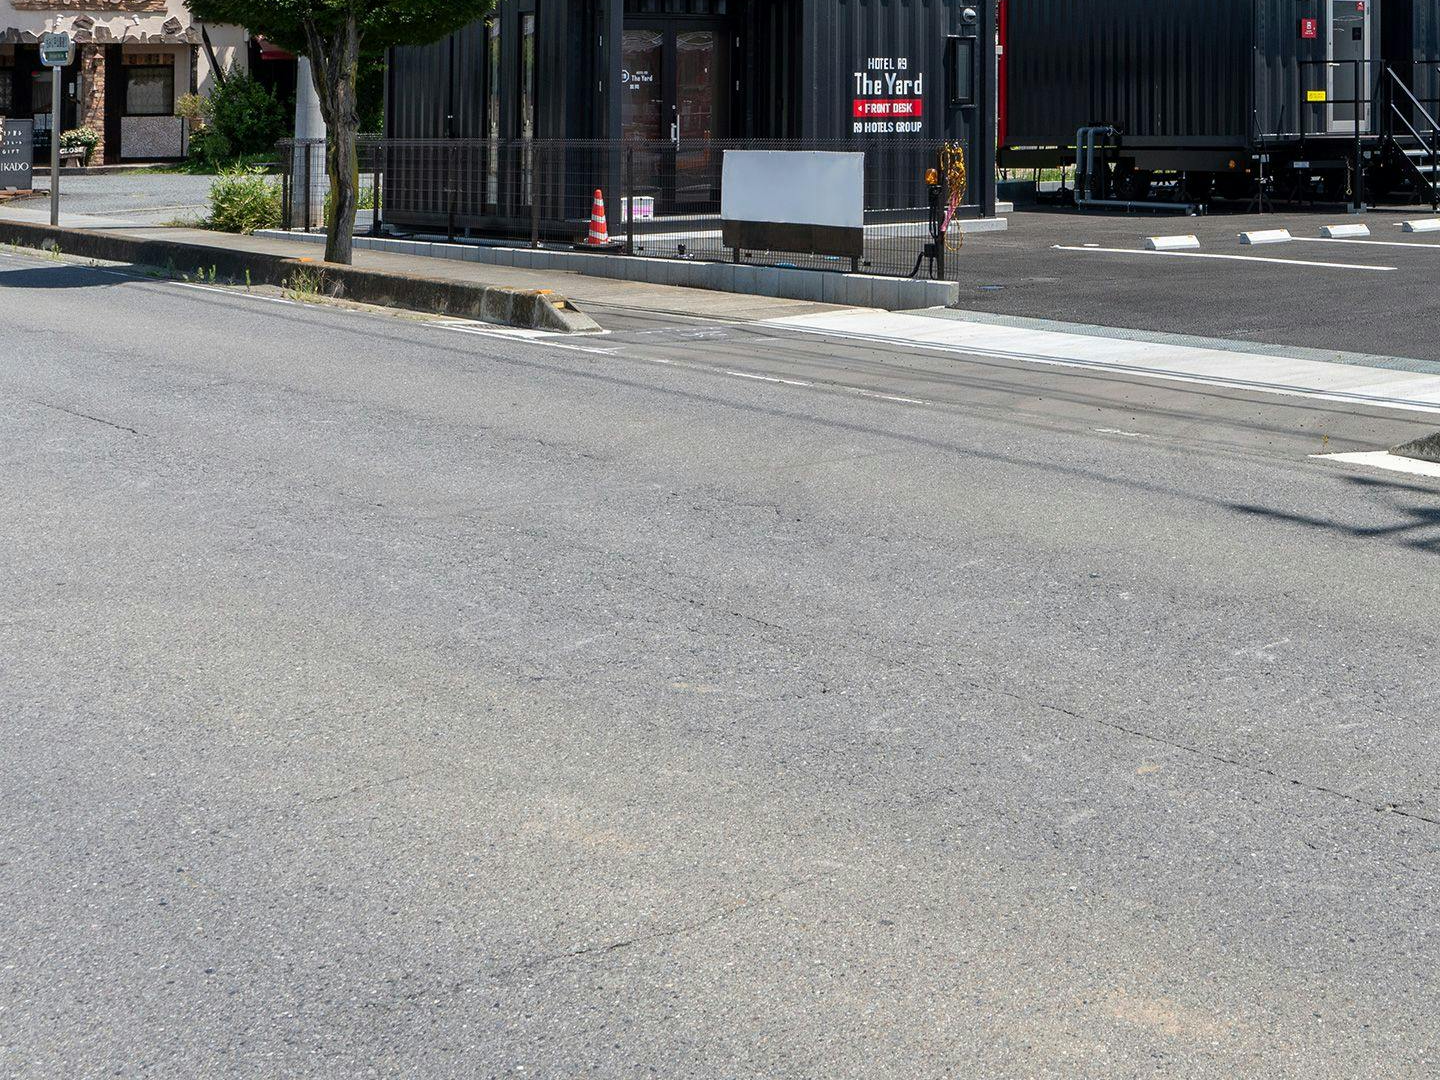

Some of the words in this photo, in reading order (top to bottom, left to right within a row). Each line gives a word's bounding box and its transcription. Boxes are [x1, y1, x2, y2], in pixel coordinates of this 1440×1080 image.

[868, 58, 894, 69] HOTEL
[897, 58, 907, 69] R9
[854, 72, 882, 95] The
[884, 72, 923, 95] Yard
[865, 103, 890, 113] FRONT
[893, 103, 912, 113] DESK
[853, 122, 862, 133] R9
[864, 122, 894, 133] HOTELS
[896, 122, 922, 133] GROUP
